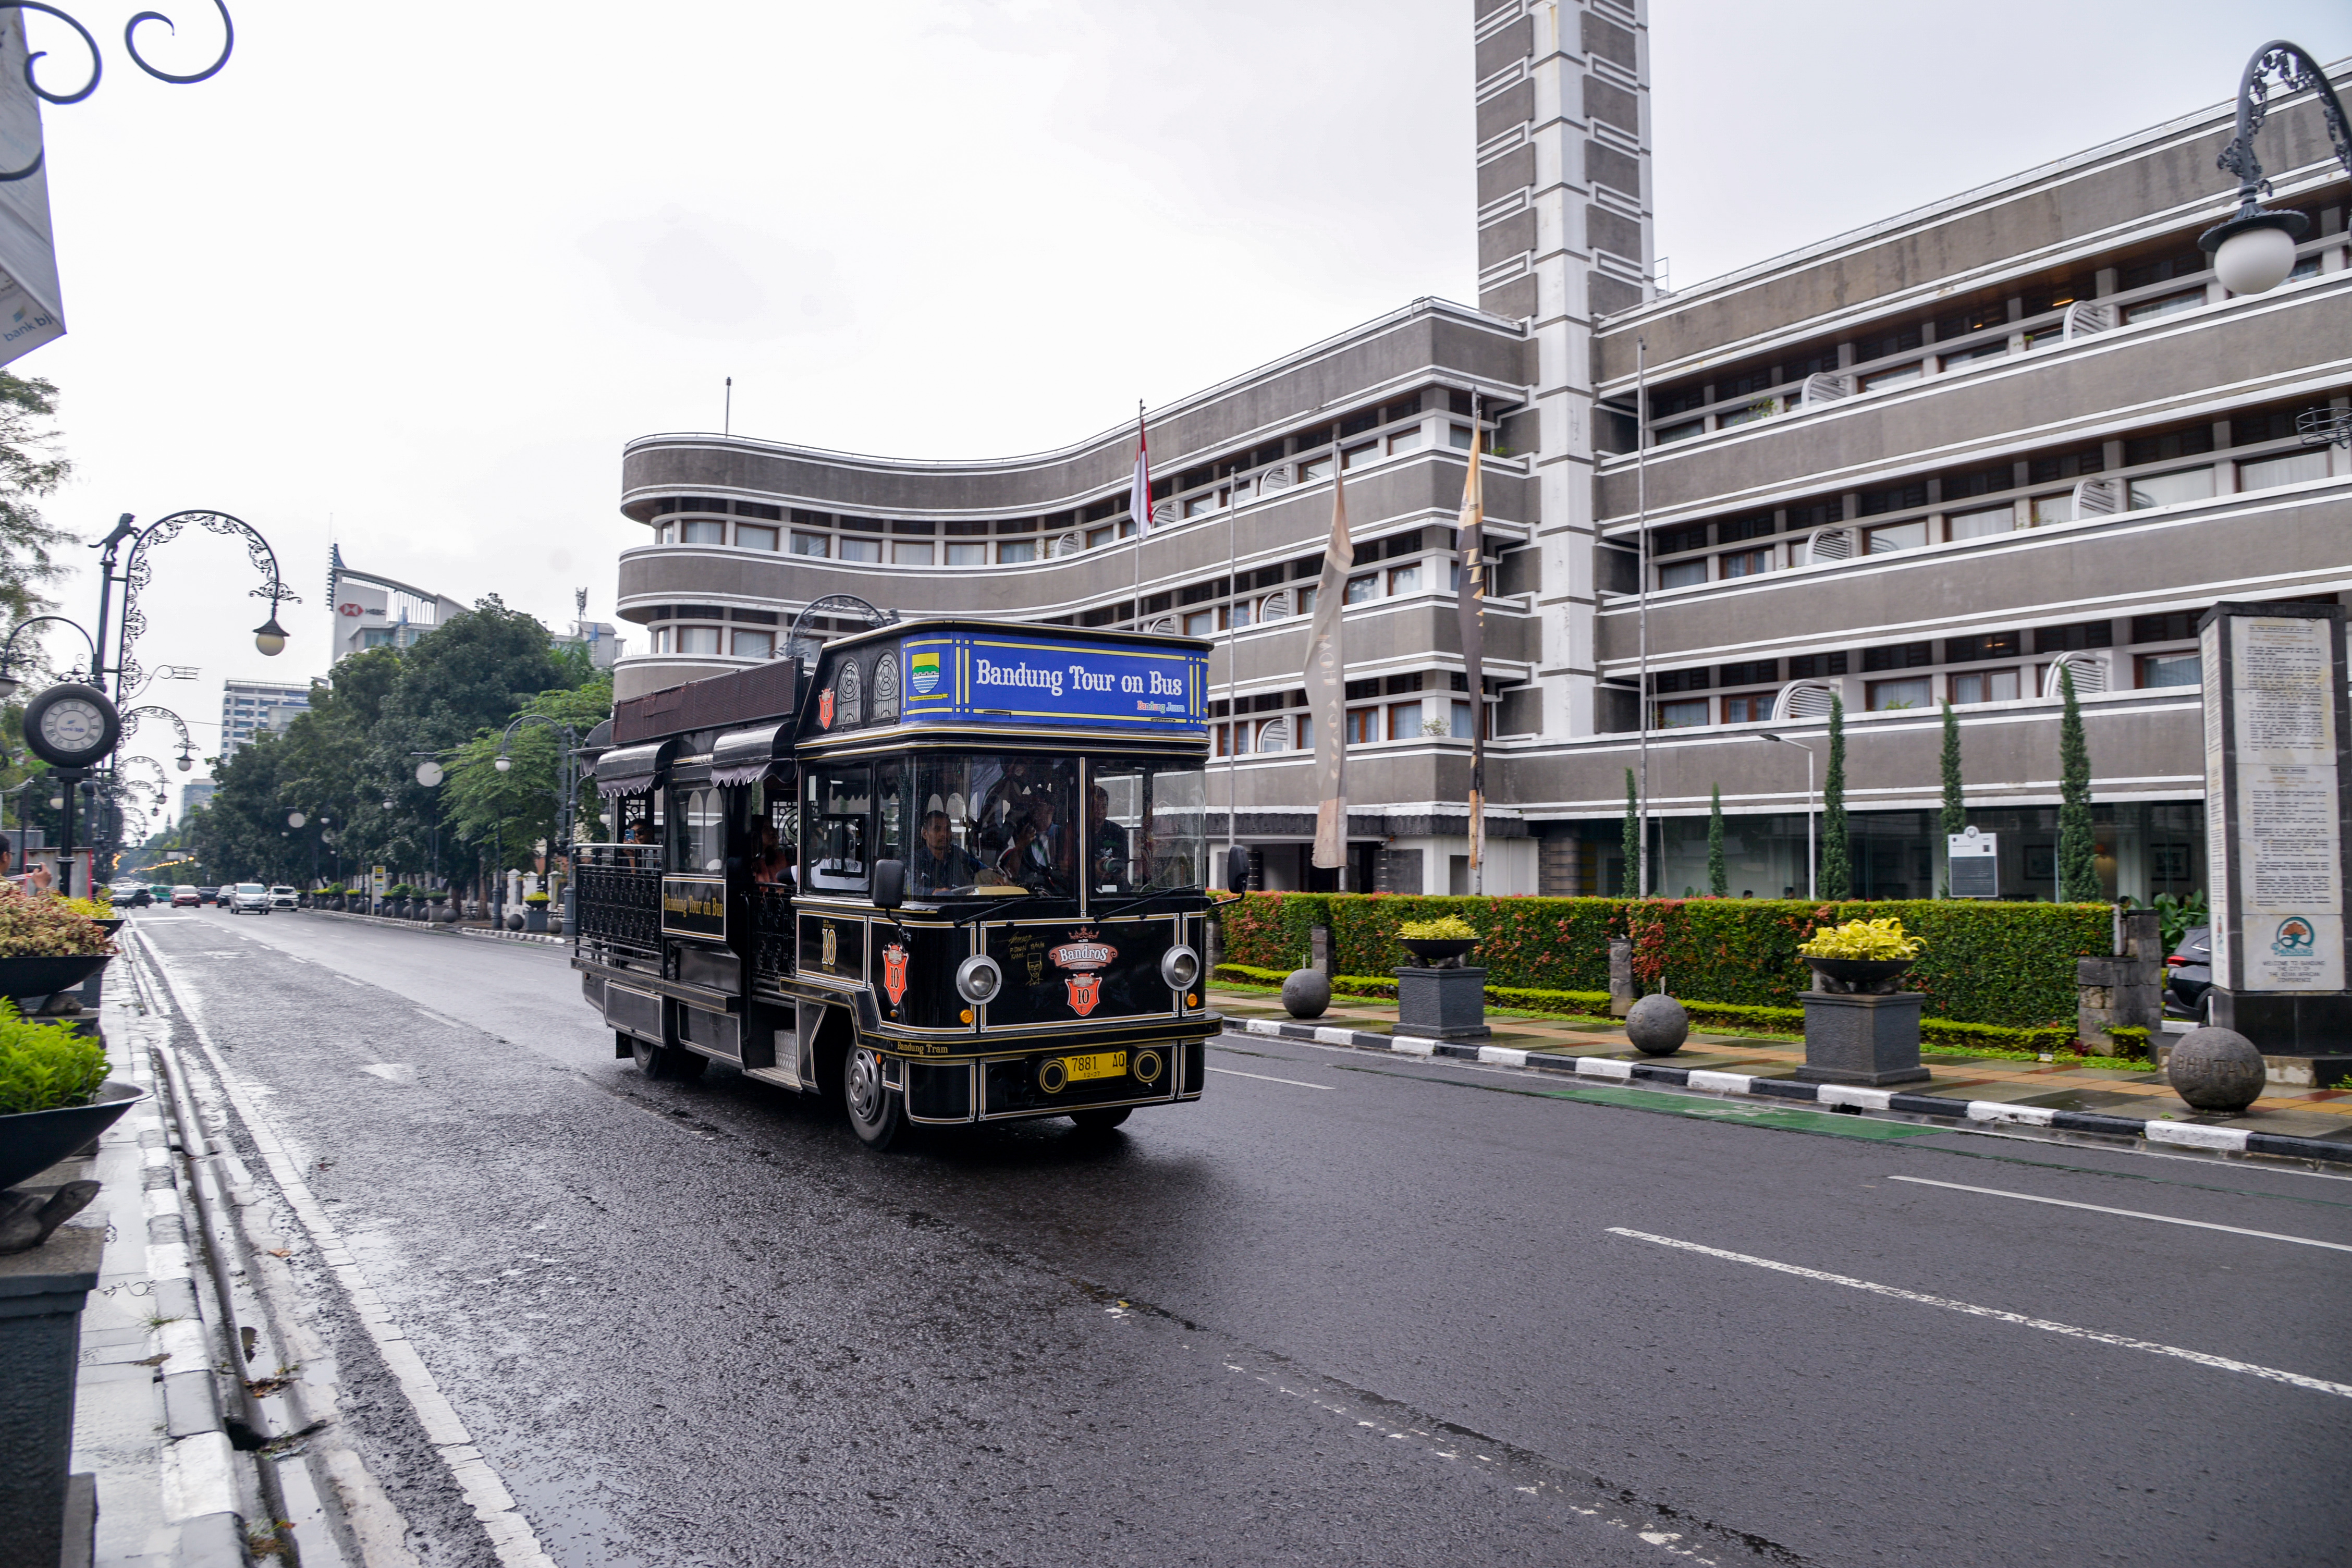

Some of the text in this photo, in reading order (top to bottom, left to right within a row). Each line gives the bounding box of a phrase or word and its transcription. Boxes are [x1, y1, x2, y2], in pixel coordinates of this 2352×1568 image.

[3, 313, 54, 341] bank bj
[976, 659, 1182, 696] Bandung Tour on Bus
[1137, 700, 1185, 714] Bandung Juara
[664, 893, 724, 918] Bandung Tour on Bus
[822, 928, 837, 965] 10
[1058, 945, 1109, 962] Bandros
[897, 1042, 948, 1055] Bandung Tram
[1071, 1056, 1097, 1072] 7881
